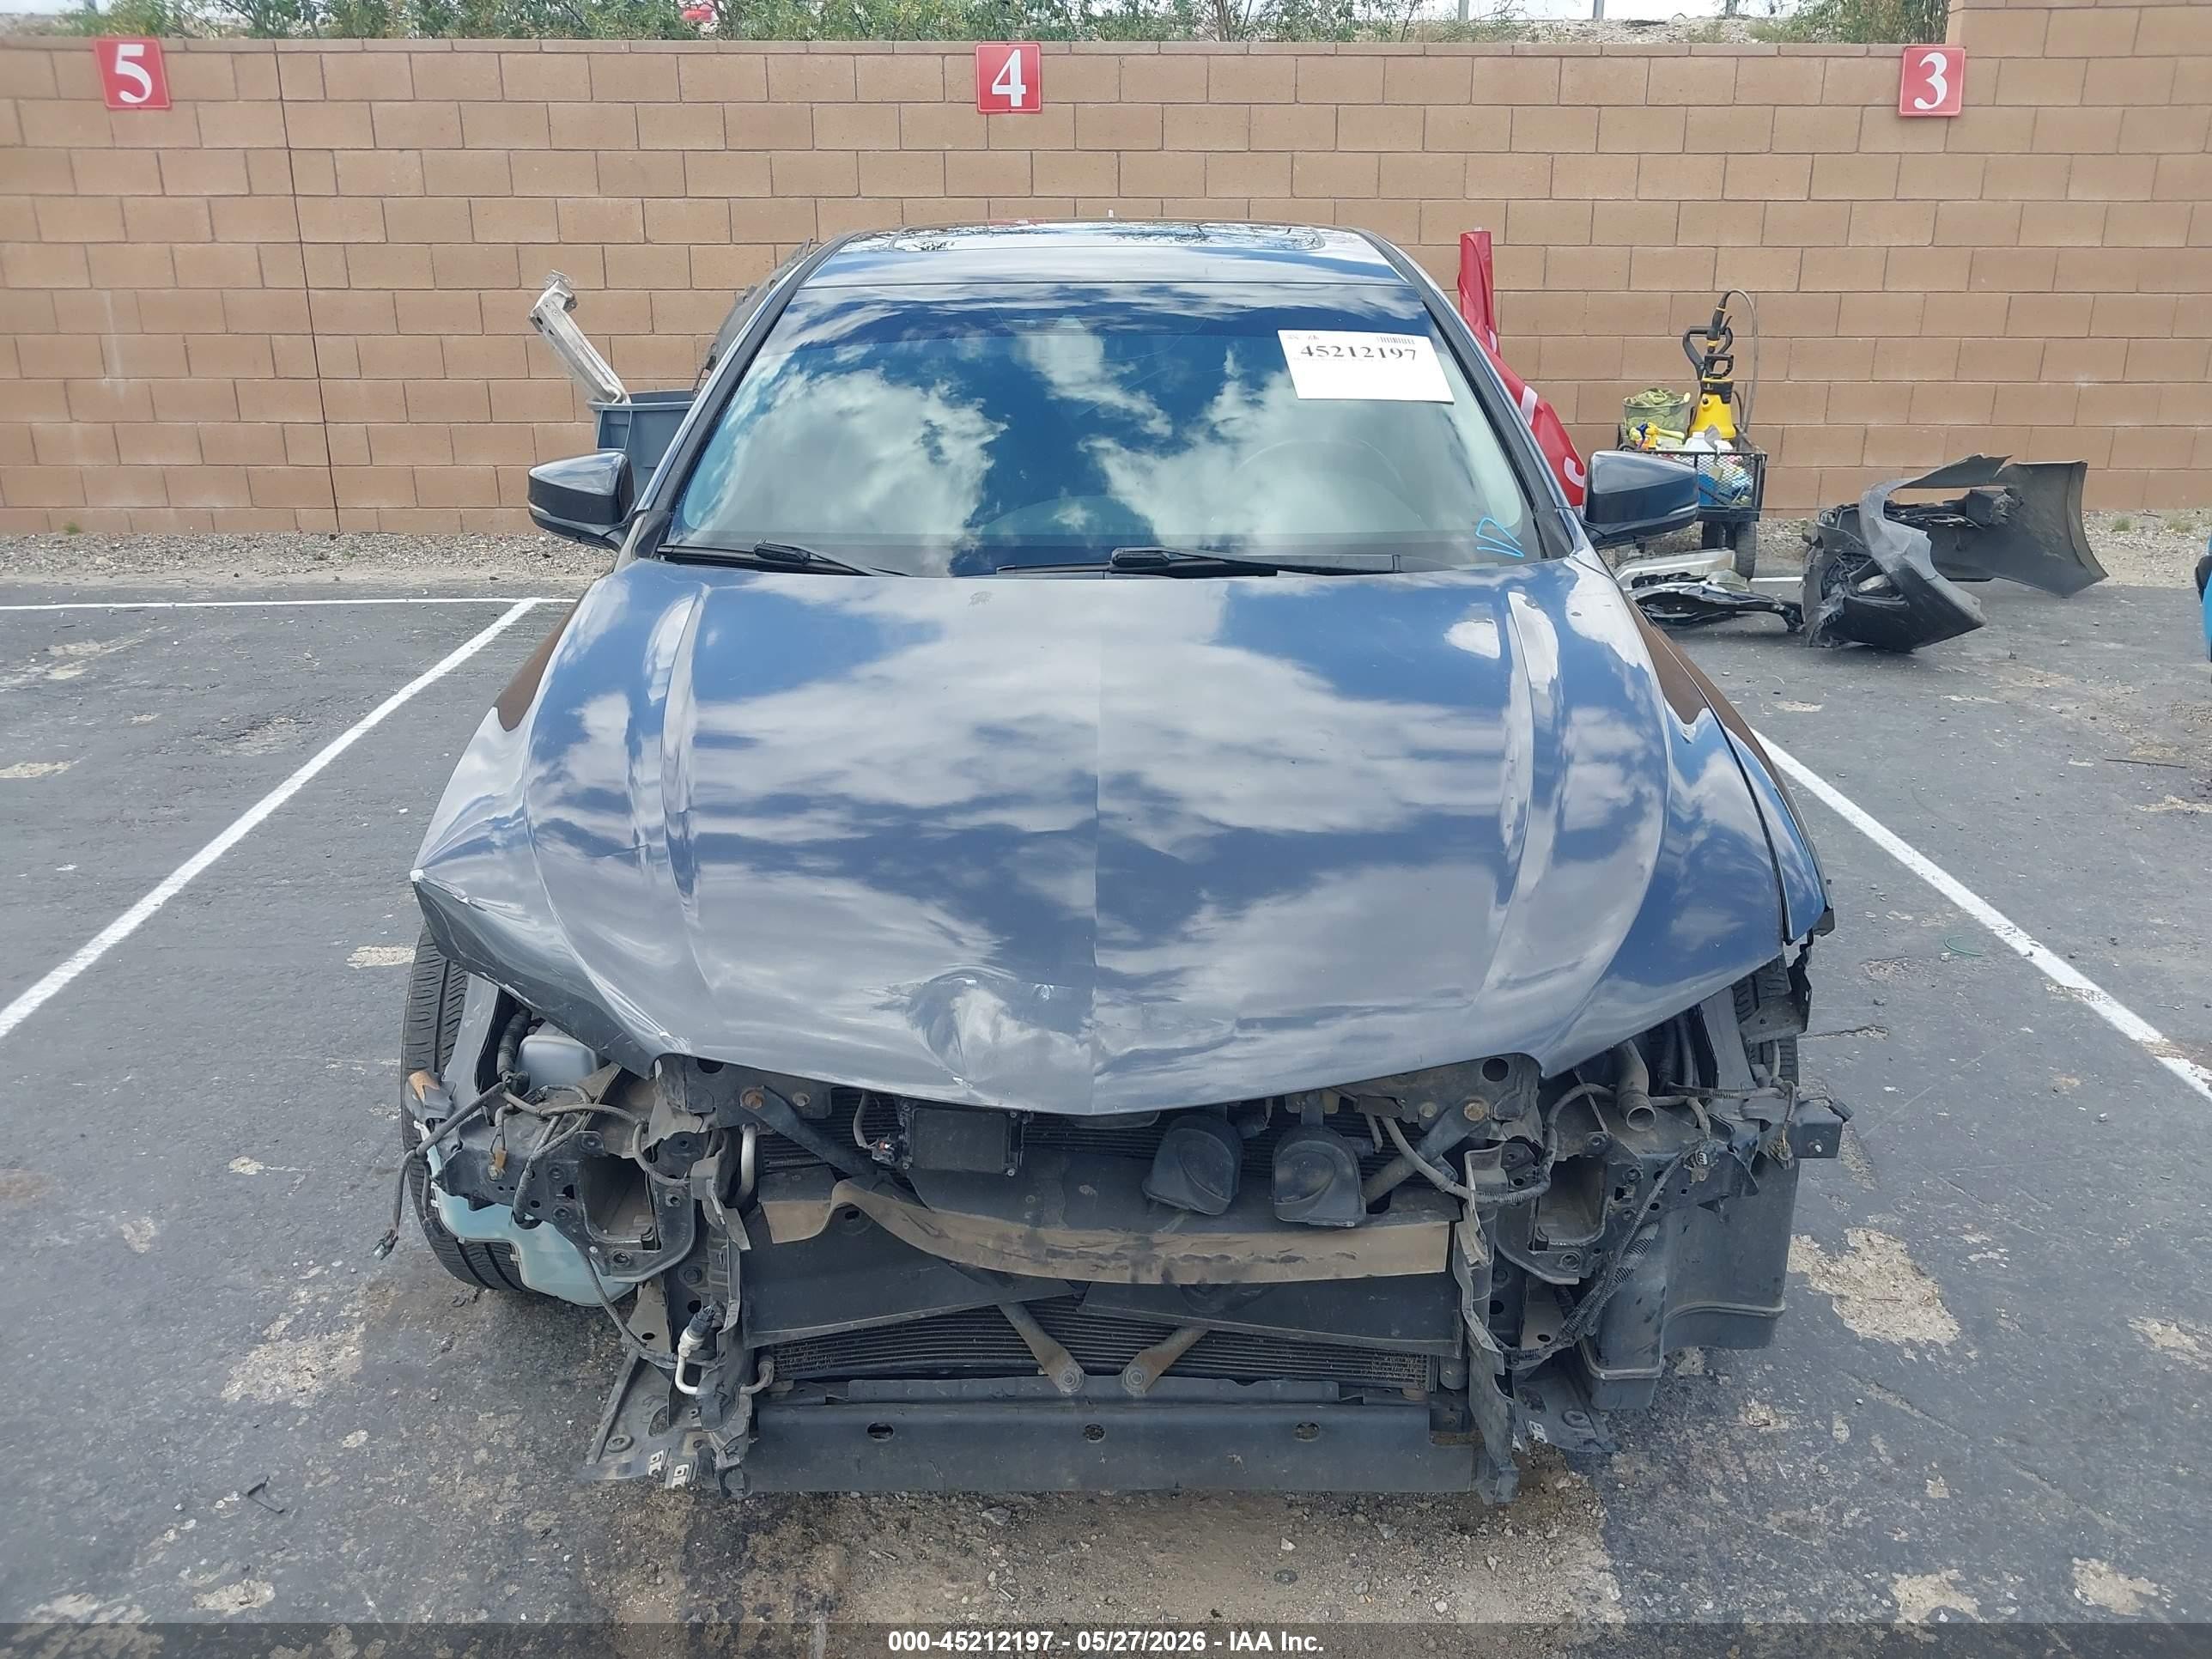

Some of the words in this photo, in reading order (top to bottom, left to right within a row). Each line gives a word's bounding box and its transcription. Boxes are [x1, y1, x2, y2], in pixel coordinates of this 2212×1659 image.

[115, 44, 152, 103] 5
[992, 49, 1026, 107] 4
[1914, 52, 1948, 109] 3
[1300, 345, 1416, 361] 45212197
